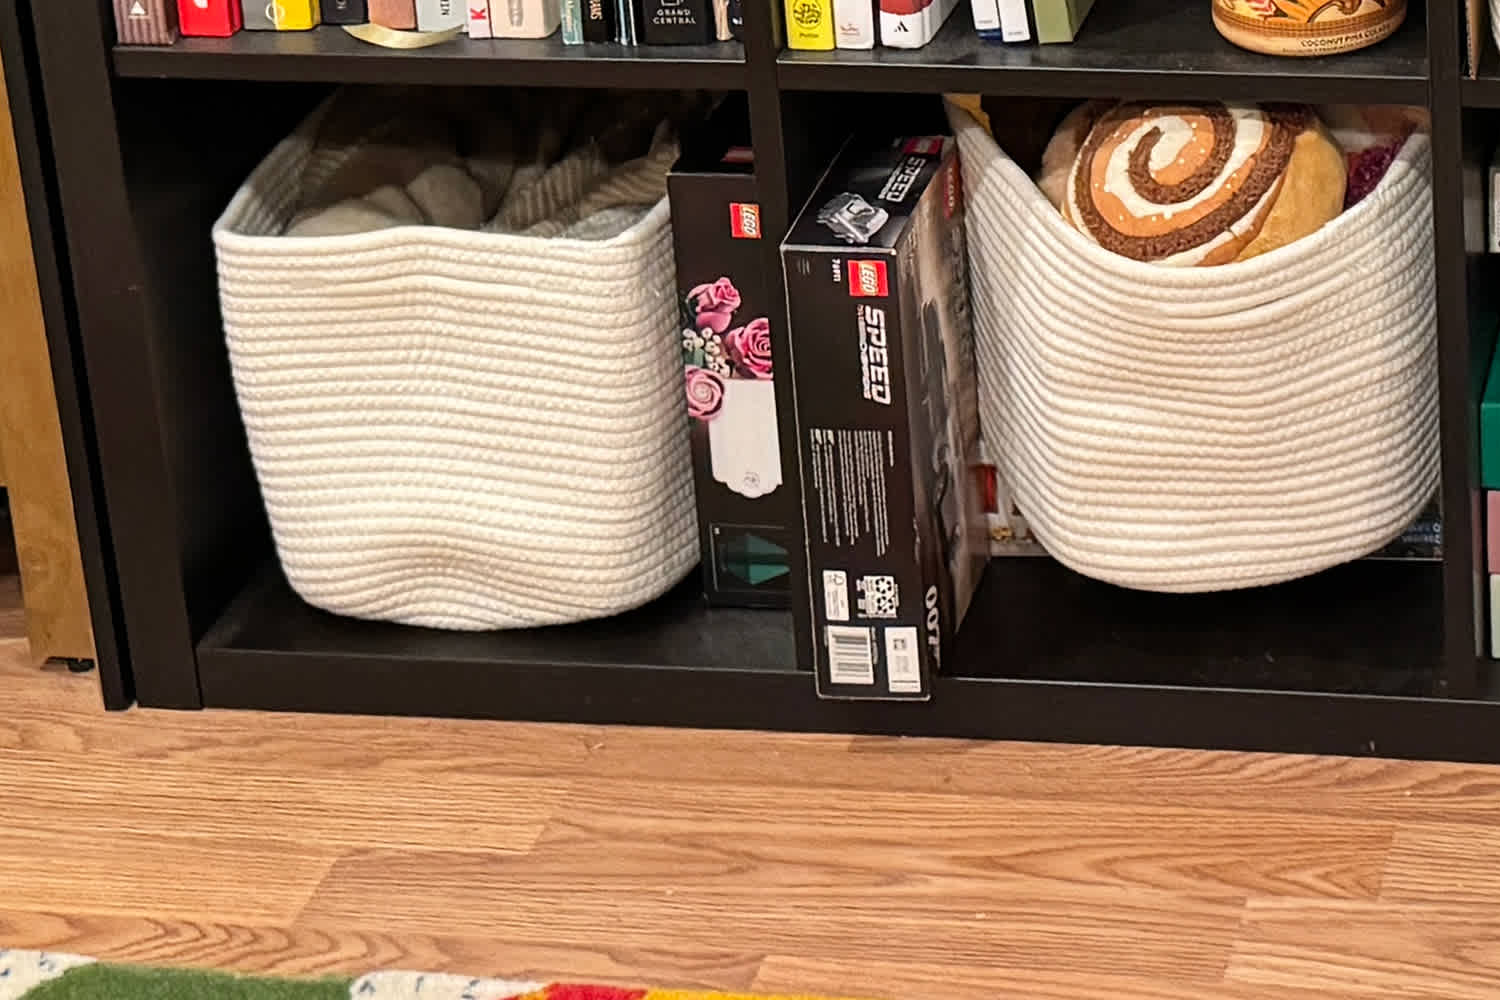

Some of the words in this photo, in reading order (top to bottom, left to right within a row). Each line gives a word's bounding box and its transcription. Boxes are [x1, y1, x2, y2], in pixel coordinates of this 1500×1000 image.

[653, 16, 697, 26] CENTRAL
[656, 8, 691, 17] GRAND
[885, 156, 927, 202] SPEED
[742, 206, 757, 236] LEGO
[860, 264, 878, 296] LEGO
[865, 305, 891, 405] SPEED
